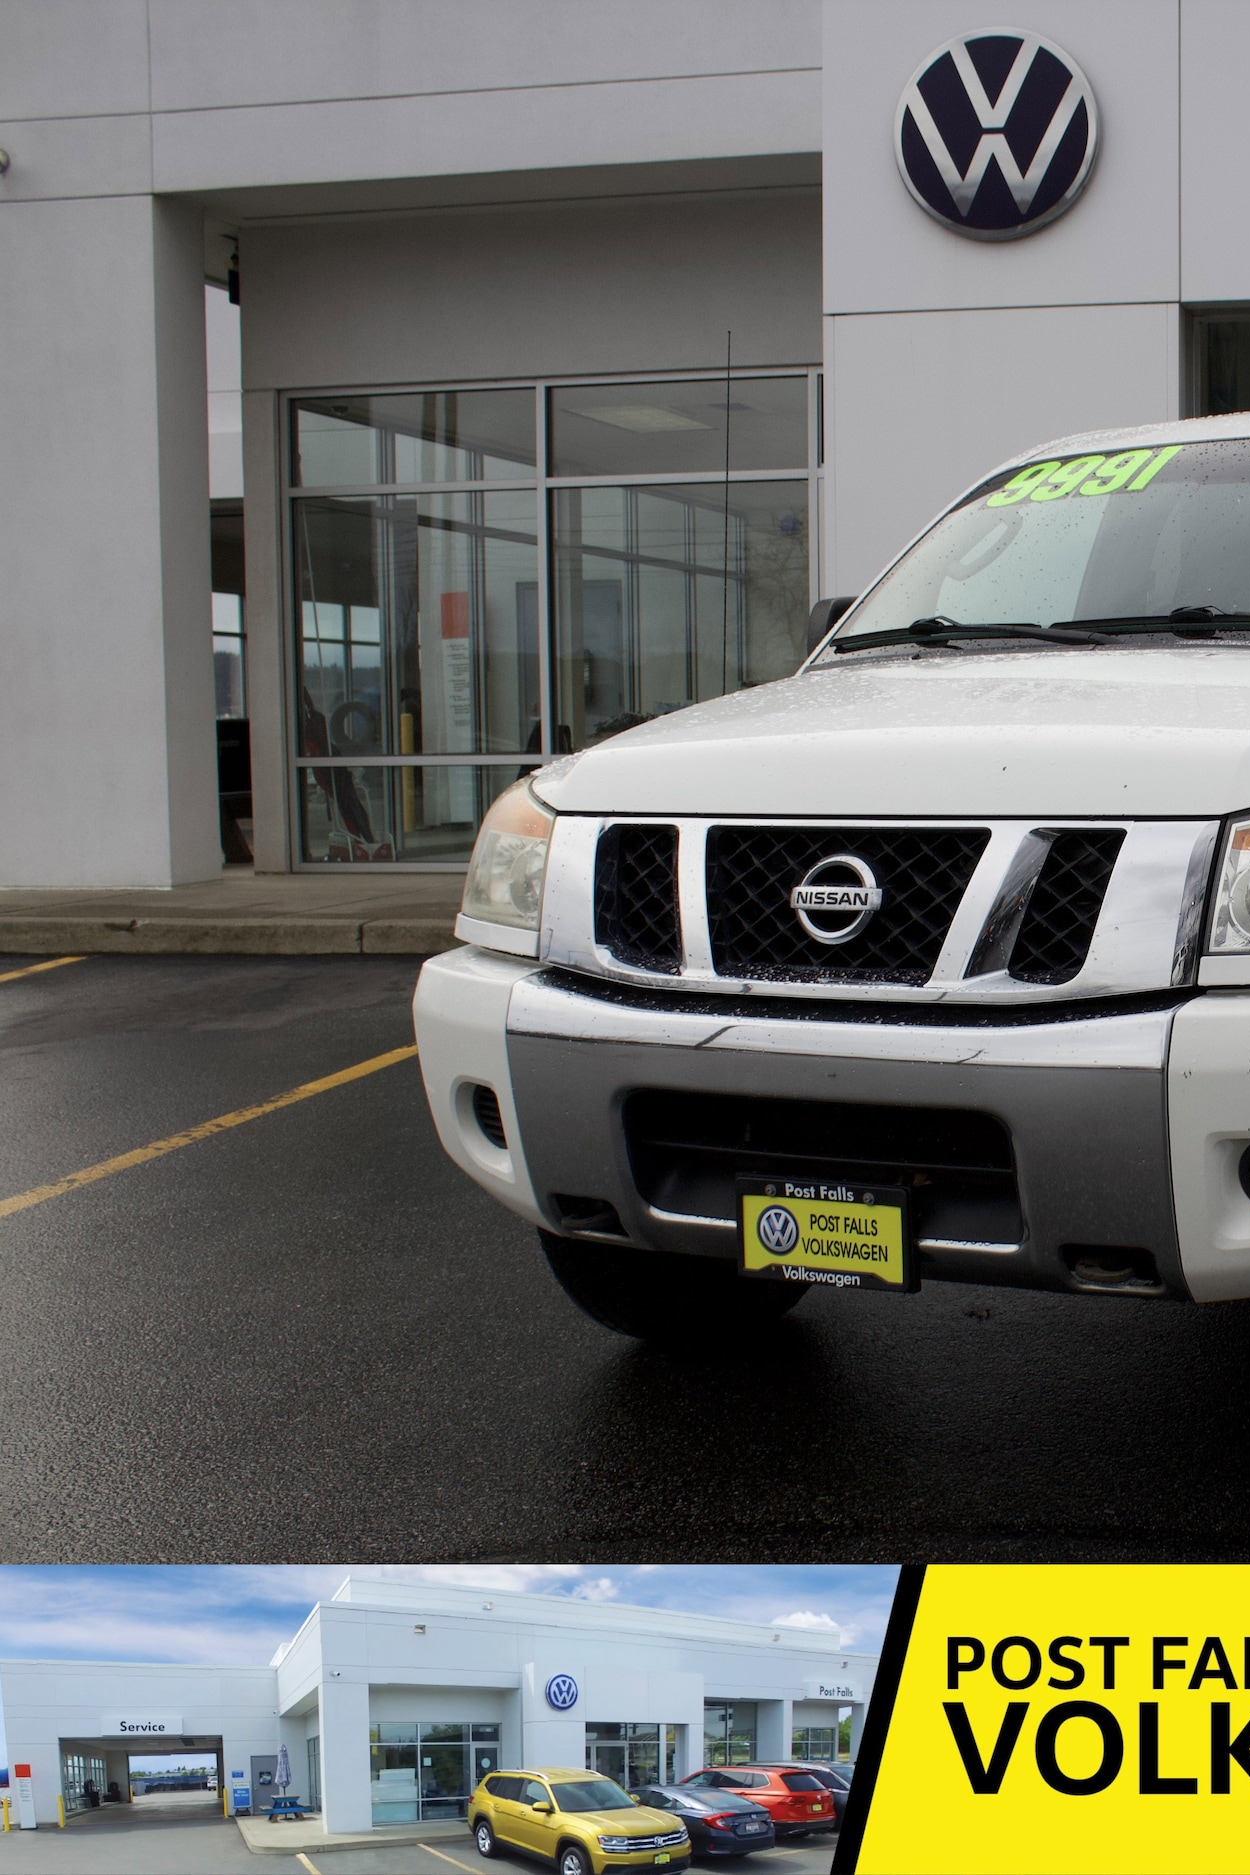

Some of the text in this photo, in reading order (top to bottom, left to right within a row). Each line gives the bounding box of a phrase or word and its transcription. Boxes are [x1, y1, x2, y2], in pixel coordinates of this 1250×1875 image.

[987, 445, 1184, 507] 9991
[796, 892, 868, 906] NISSAN
[784, 1183, 854, 1201] Post Falls
[810, 1214, 878, 1236] POST FALLS
[802, 1237, 888, 1262] VOLKSWAGEN
[782, 1265, 860, 1287] Volkswagen
